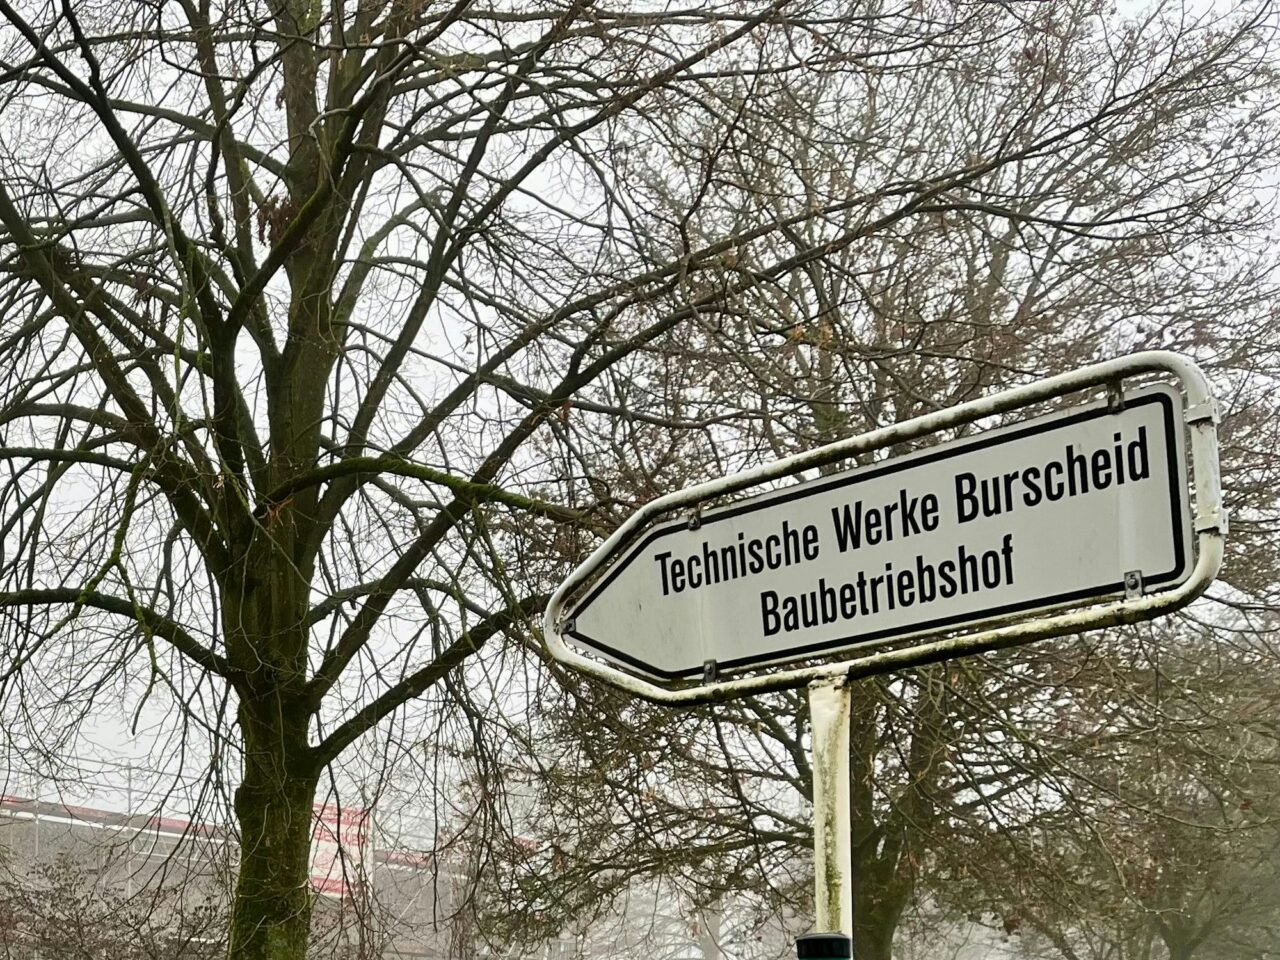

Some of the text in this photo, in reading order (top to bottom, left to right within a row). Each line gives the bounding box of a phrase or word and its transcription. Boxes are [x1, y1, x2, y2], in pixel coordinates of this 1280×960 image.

[654, 425, 1150, 596] Technische Werke Burscheid
[760, 533, 1014, 637] Baubetriebshof
